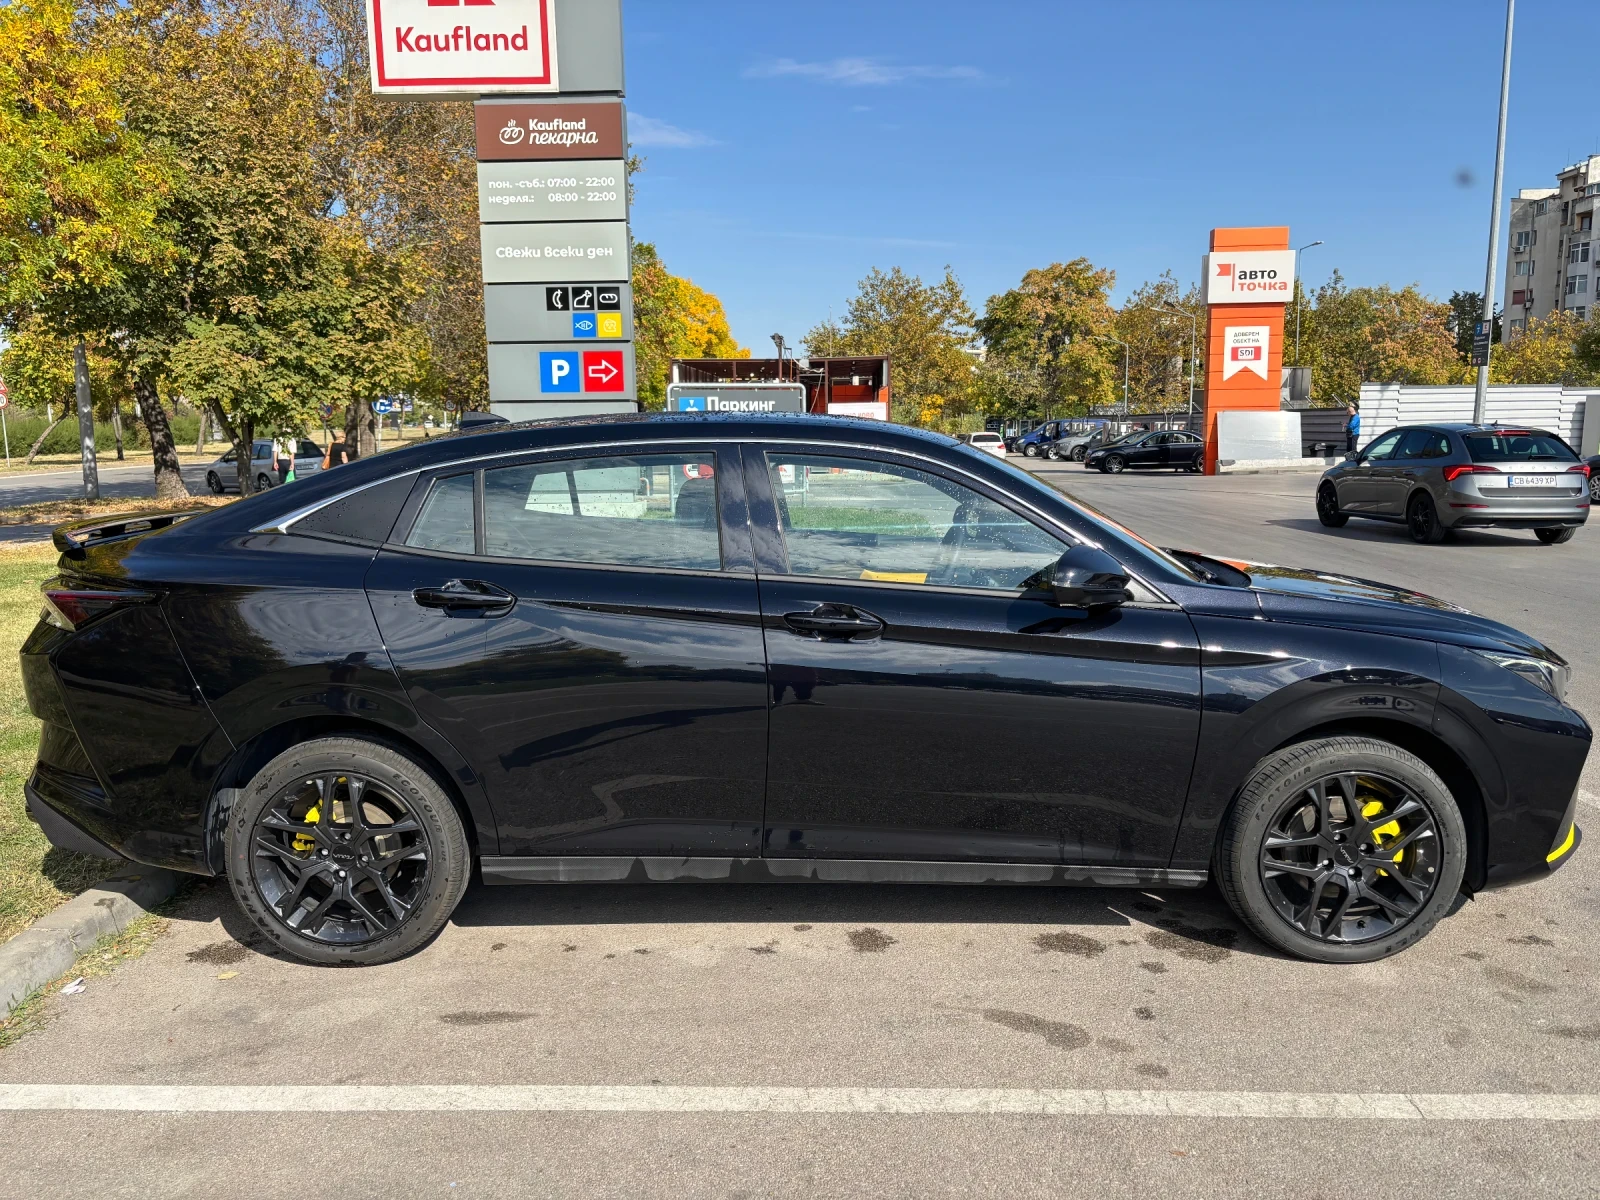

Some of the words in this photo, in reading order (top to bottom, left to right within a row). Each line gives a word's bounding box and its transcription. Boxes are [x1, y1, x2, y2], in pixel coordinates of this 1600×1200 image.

[395, 25, 528, 52] Kaufland
[529, 118, 586, 131] Kaufland
[529, 130, 598, 147] пекарна
[488, 180, 513, 189] пон.
[547, 178, 576, 188] 07:00
[585, 177, 615, 187] 22:00
[548, 192, 578, 203] 08:00
[587, 191, 616, 202] 22:00
[495, 246, 541, 258] Свежи
[544, 245, 584, 257] всеки
[587, 246, 613, 259] ден
[1238, 269, 1277, 280] авто
[1238, 281, 1288, 292] точка
[1239, 349, 1253, 357] SDI
[551, 359, 570, 385] P
[707, 396, 775, 411] Паркинг
[1526, 477, 1543, 485] 6439
[392, 773, 442, 833] ECOTOUR
